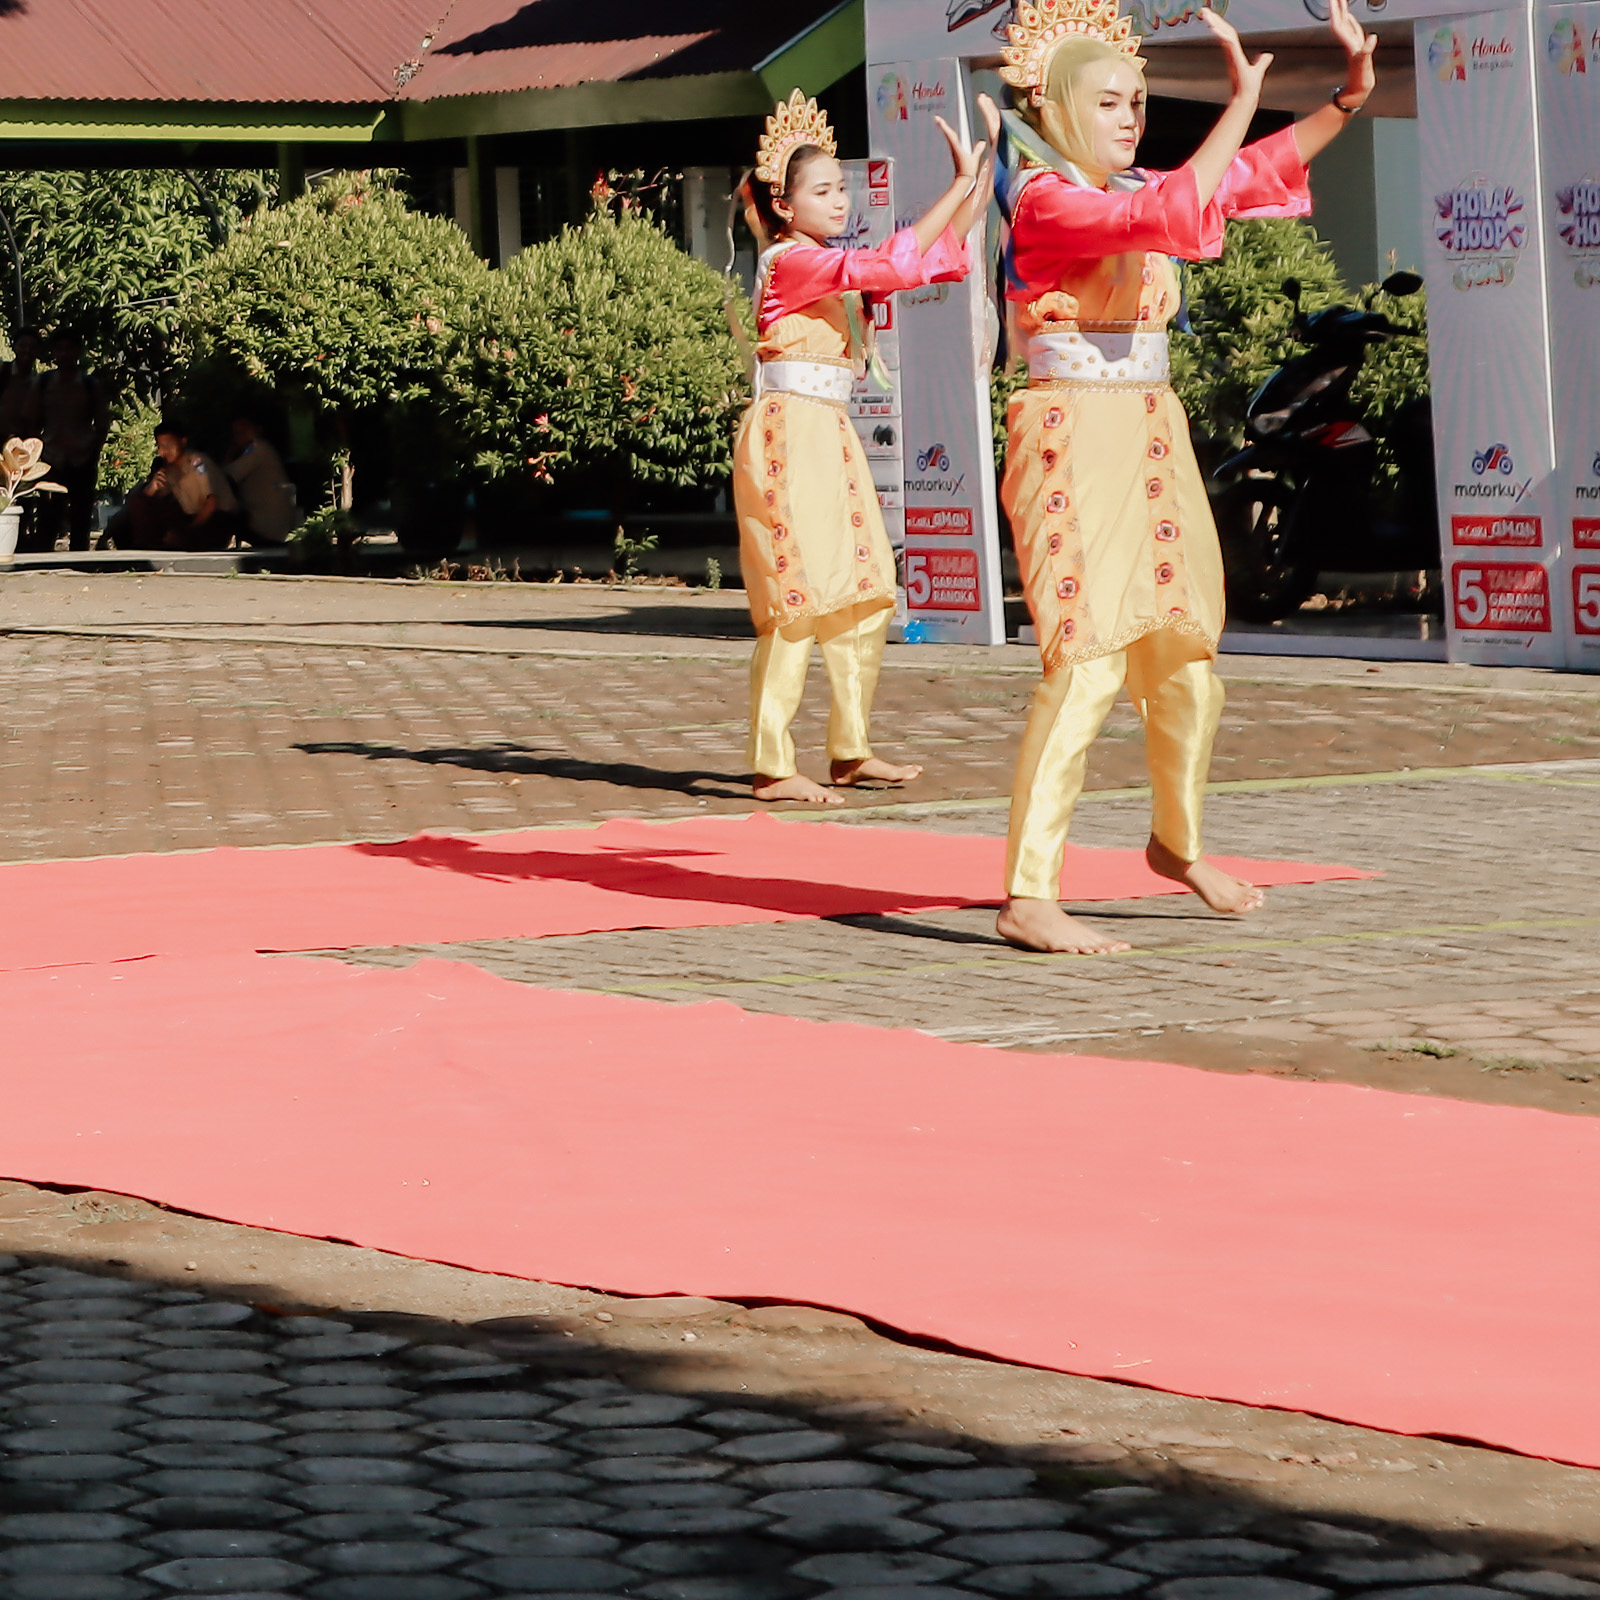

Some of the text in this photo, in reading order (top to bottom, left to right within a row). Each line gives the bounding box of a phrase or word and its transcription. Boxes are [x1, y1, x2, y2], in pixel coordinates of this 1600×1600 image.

[1471, 37, 1514, 58] Honda
[912, 81, 945, 99] Honda
[1452, 188, 1508, 220] HOLA
[1453, 219, 1509, 251] HOOP
[904, 473, 965, 496] motorkuX
[1455, 477, 1533, 503] motorkuX
[908, 555, 931, 605] 5
[932, 576, 976, 590] GARANSI
[934, 590, 975, 603] RANGKA
[1458, 569, 1488, 625] 5
[1489, 592, 1545, 608] GARANSI
[1490, 609, 1544, 624] RANGKA
